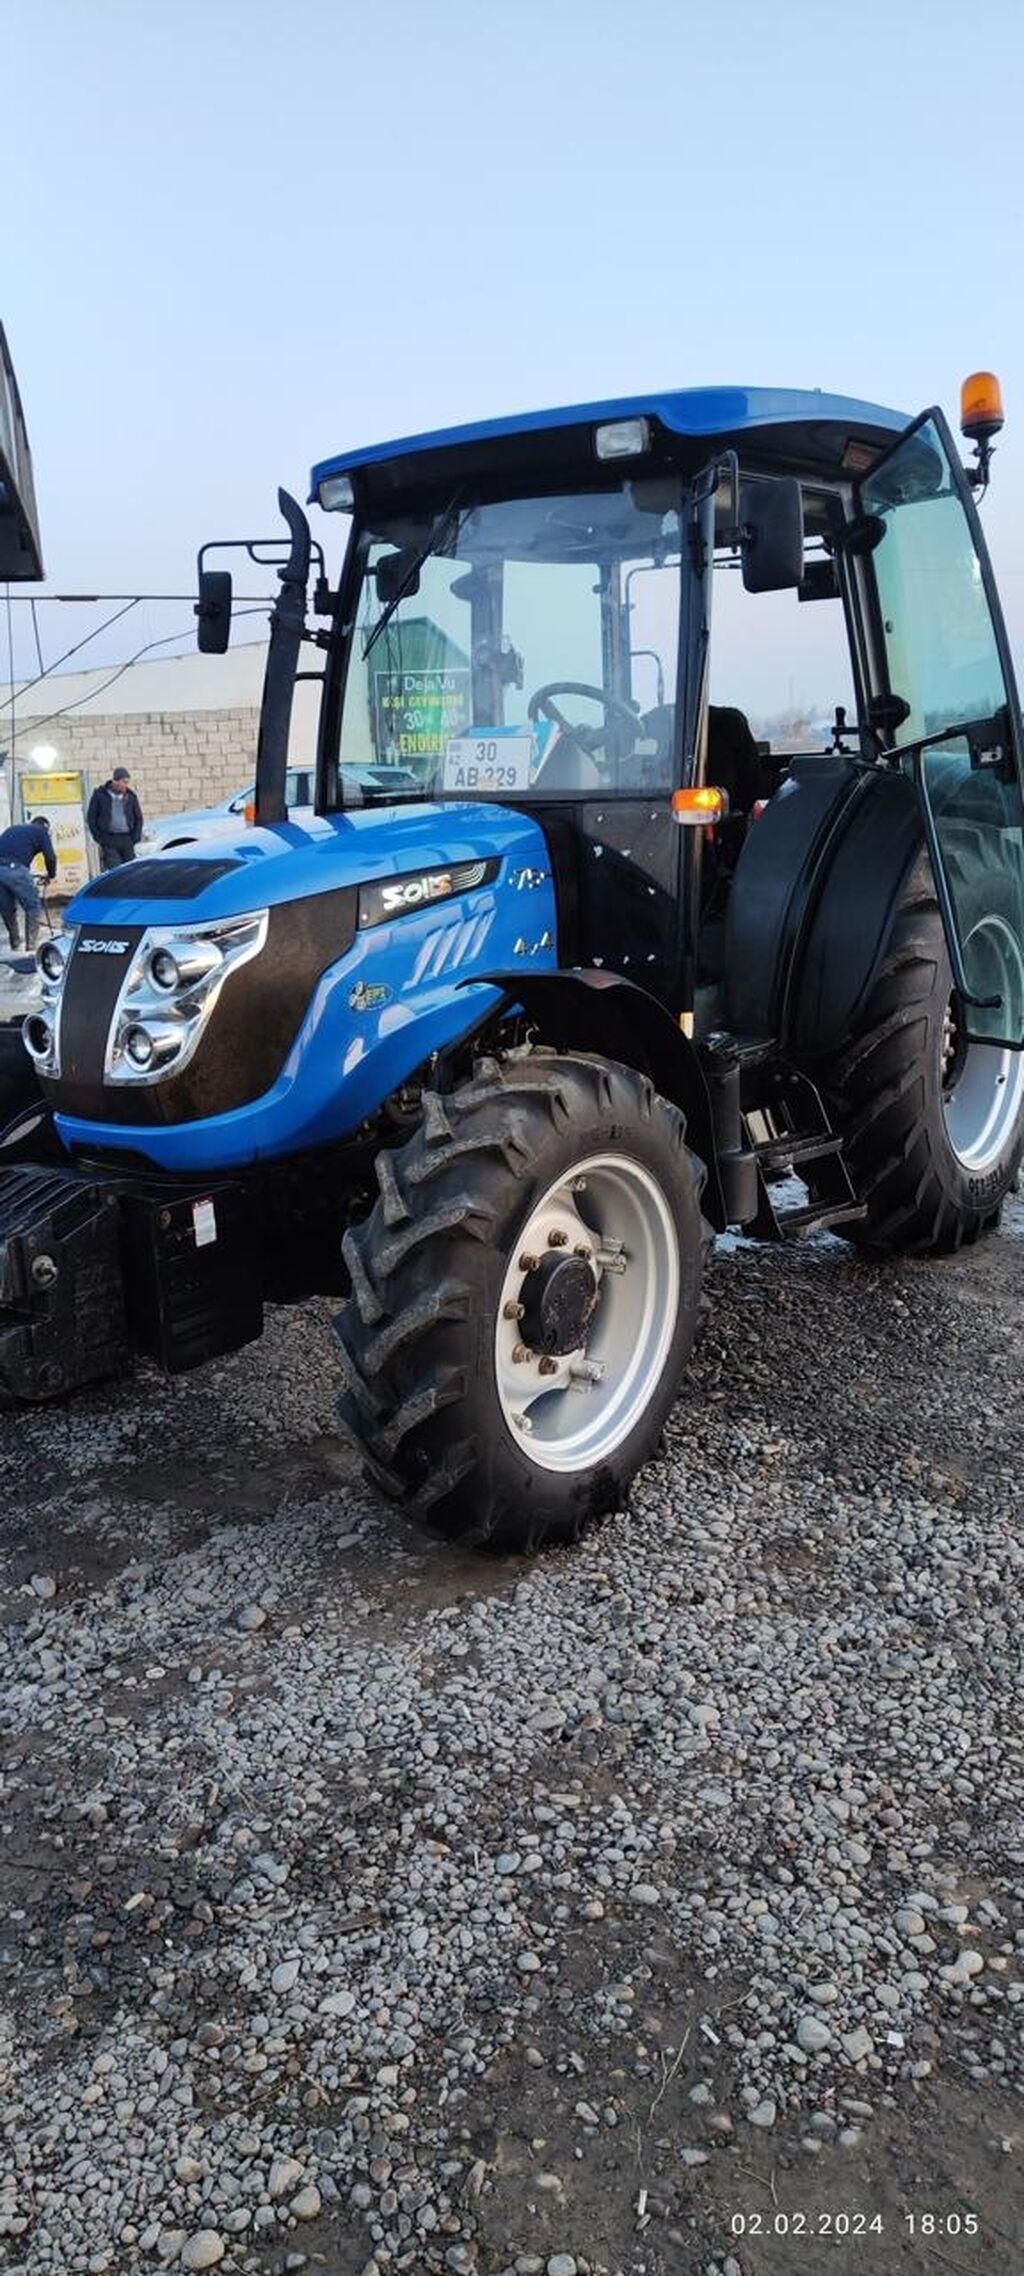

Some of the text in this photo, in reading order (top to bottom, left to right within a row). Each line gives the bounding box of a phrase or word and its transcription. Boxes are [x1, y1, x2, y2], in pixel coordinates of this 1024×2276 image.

[475, 741, 497, 762] 30
[455, 766, 517, 787] AB 229
